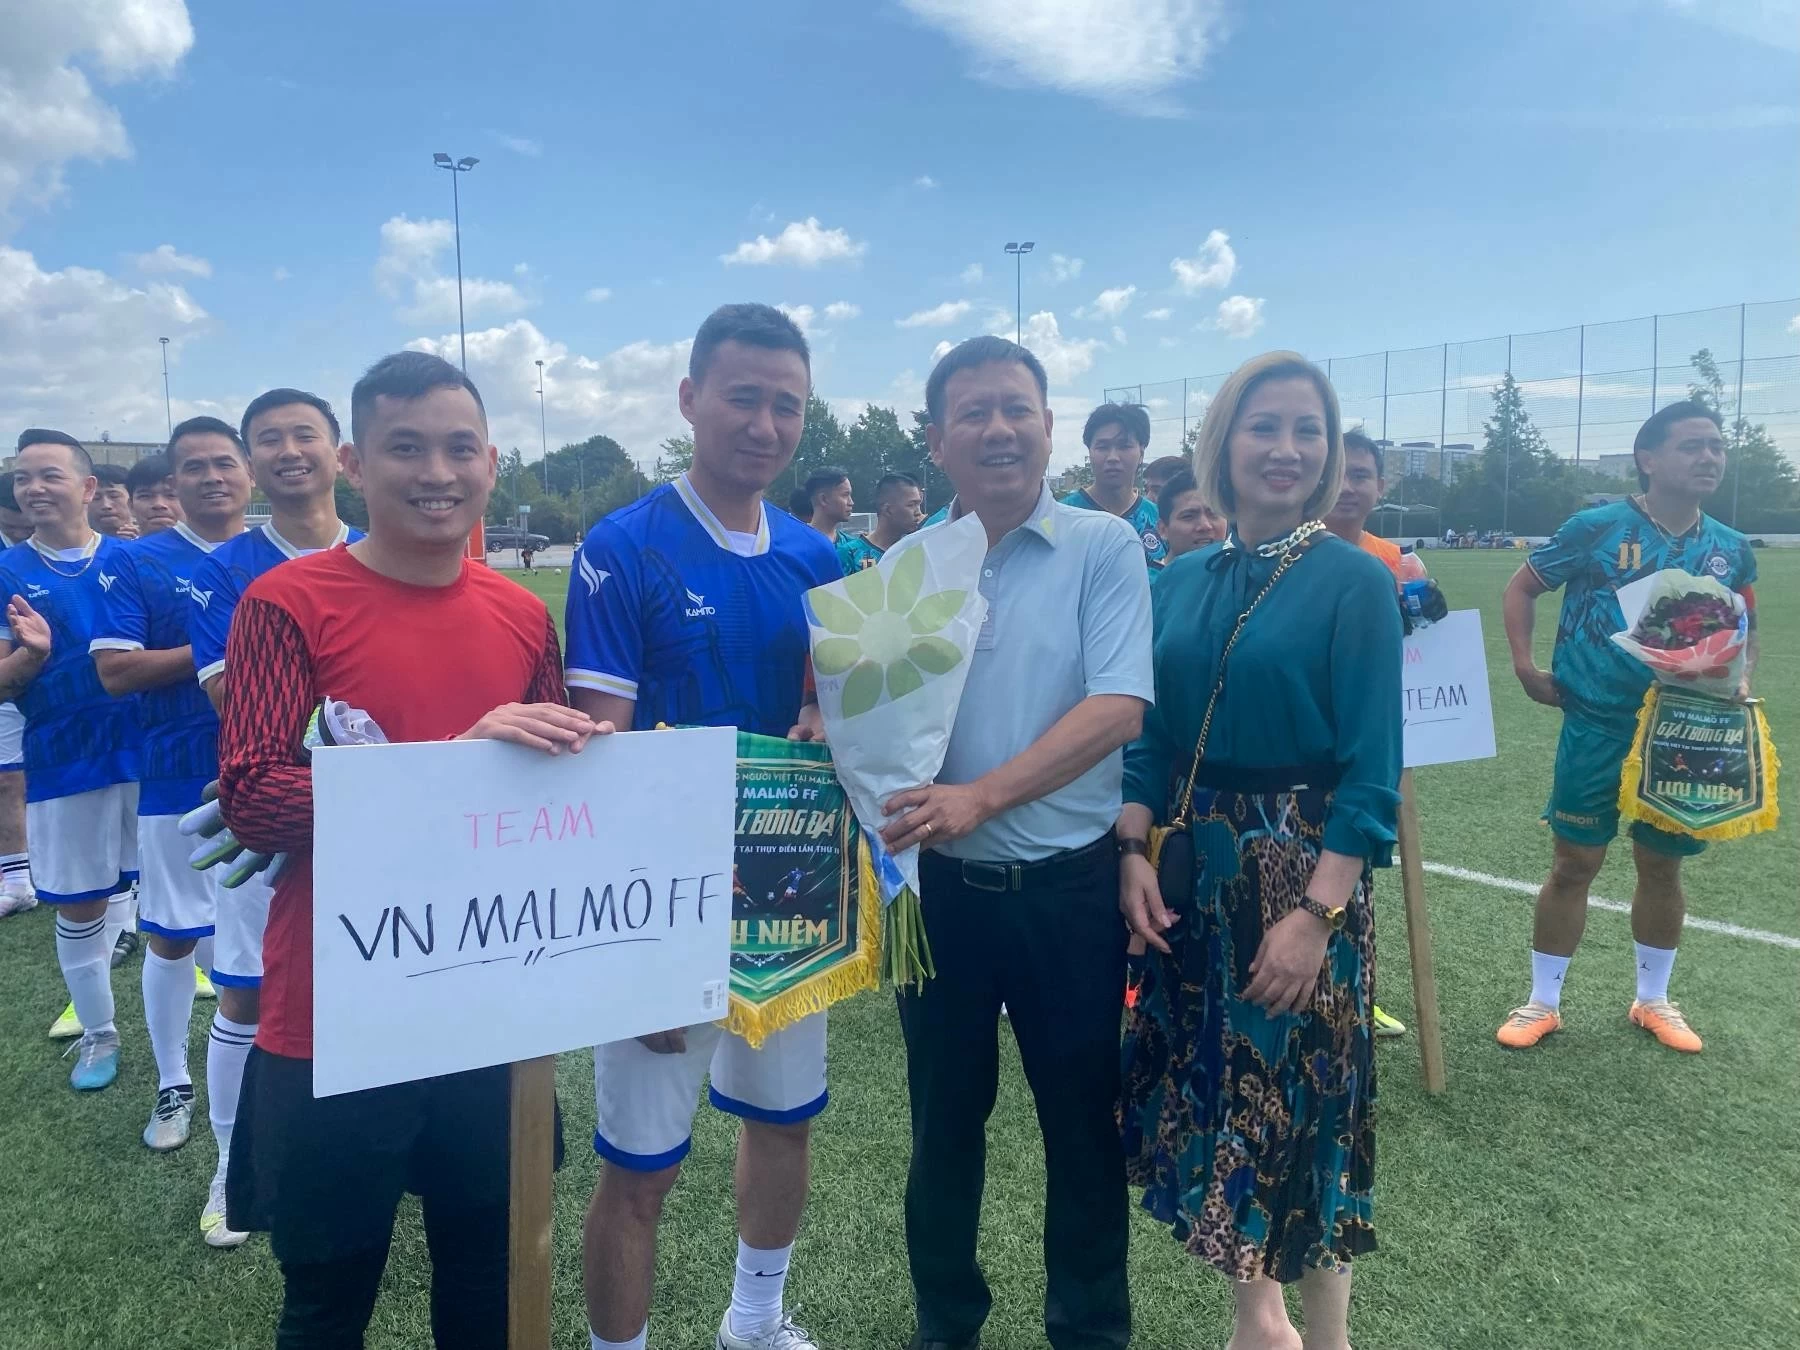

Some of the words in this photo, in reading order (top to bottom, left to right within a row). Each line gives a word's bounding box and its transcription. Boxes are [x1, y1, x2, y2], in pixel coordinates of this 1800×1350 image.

[1618, 543, 1641, 570] 11
[685, 606, 715, 617] KAMITO
[1402, 684, 1468, 711] TEAM
[1673, 711, 1686, 719] VN
[743, 784, 799, 799] MALMÖ
[802, 789, 819, 800] FF
[464, 802, 595, 849] TEAM
[749, 804, 809, 836] BÓNG
[338, 903, 435, 961] VN
[668, 872, 725, 928] FF
